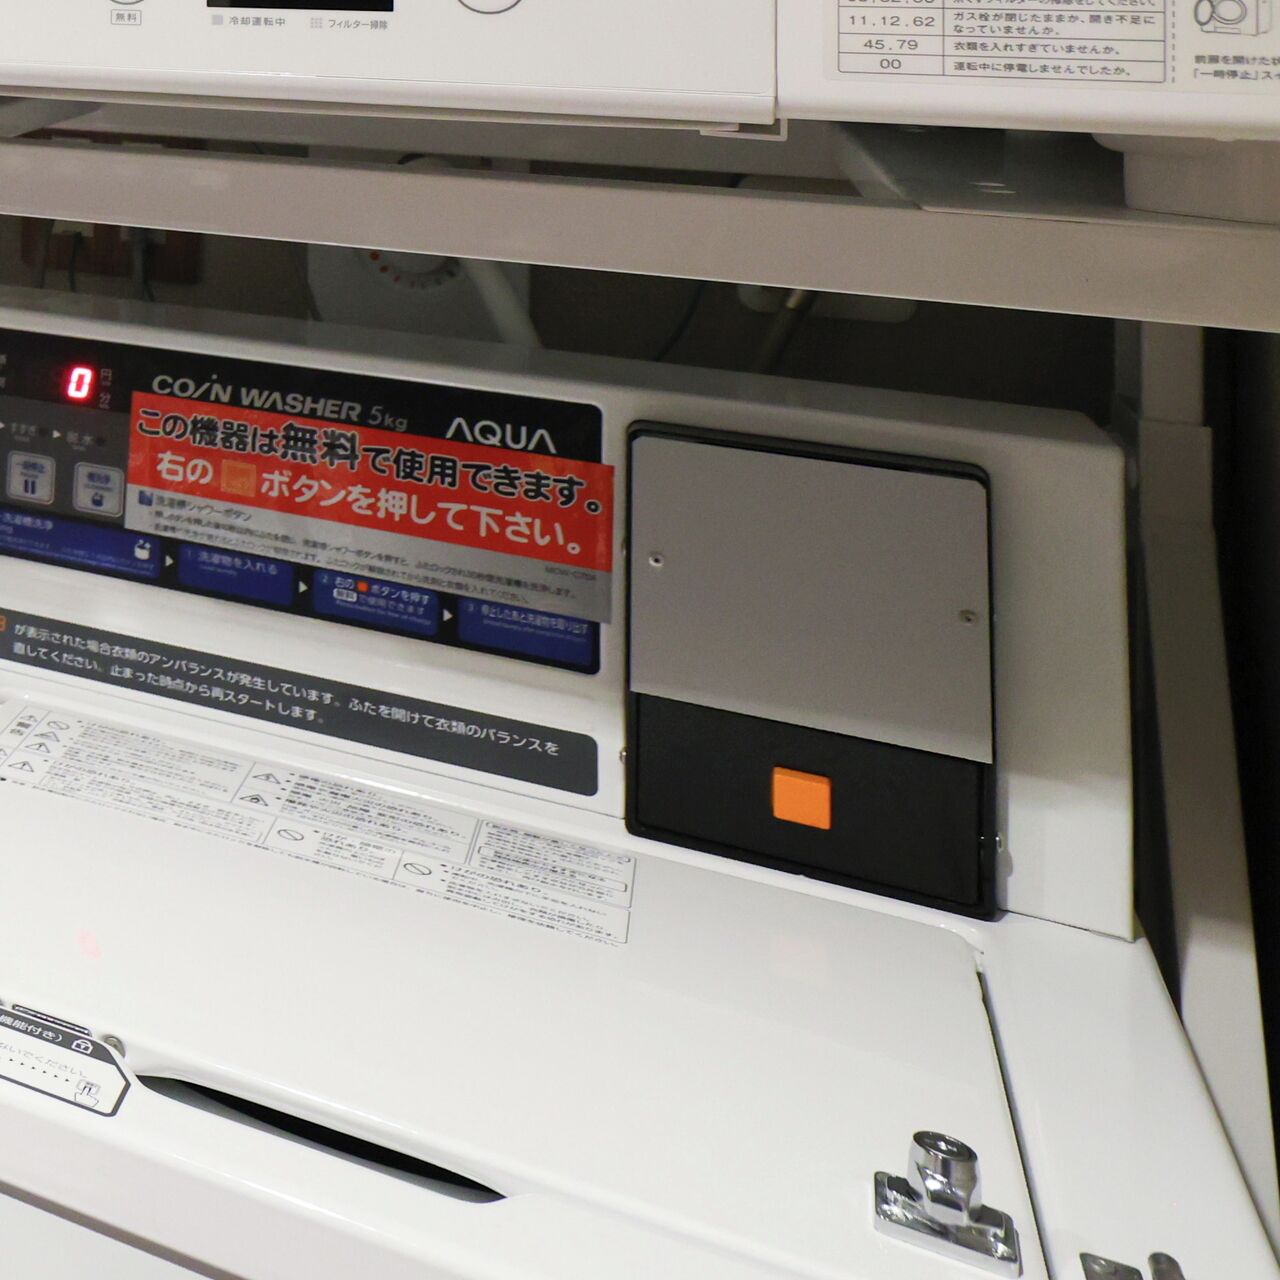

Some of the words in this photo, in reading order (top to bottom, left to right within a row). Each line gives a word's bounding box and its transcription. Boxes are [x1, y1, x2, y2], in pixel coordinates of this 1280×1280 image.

[114, 11, 139, 24] 無料
[327, 19, 389, 31] フィルター掃除
[952, 24, 1060, 36] なっていませんか。
[880, 58, 902, 70] 00
[67, 366, 93, 399] 0
[241, 386, 362, 420] WASHER
[368, 405, 408, 432] 5kg
[445, 417, 557, 454] AQUA
[137, 408, 602, 514] この機器は無料で使用できます。
[156, 450, 214, 484] 右の
[261, 470, 581, 555] ボタンを押して下さい。
